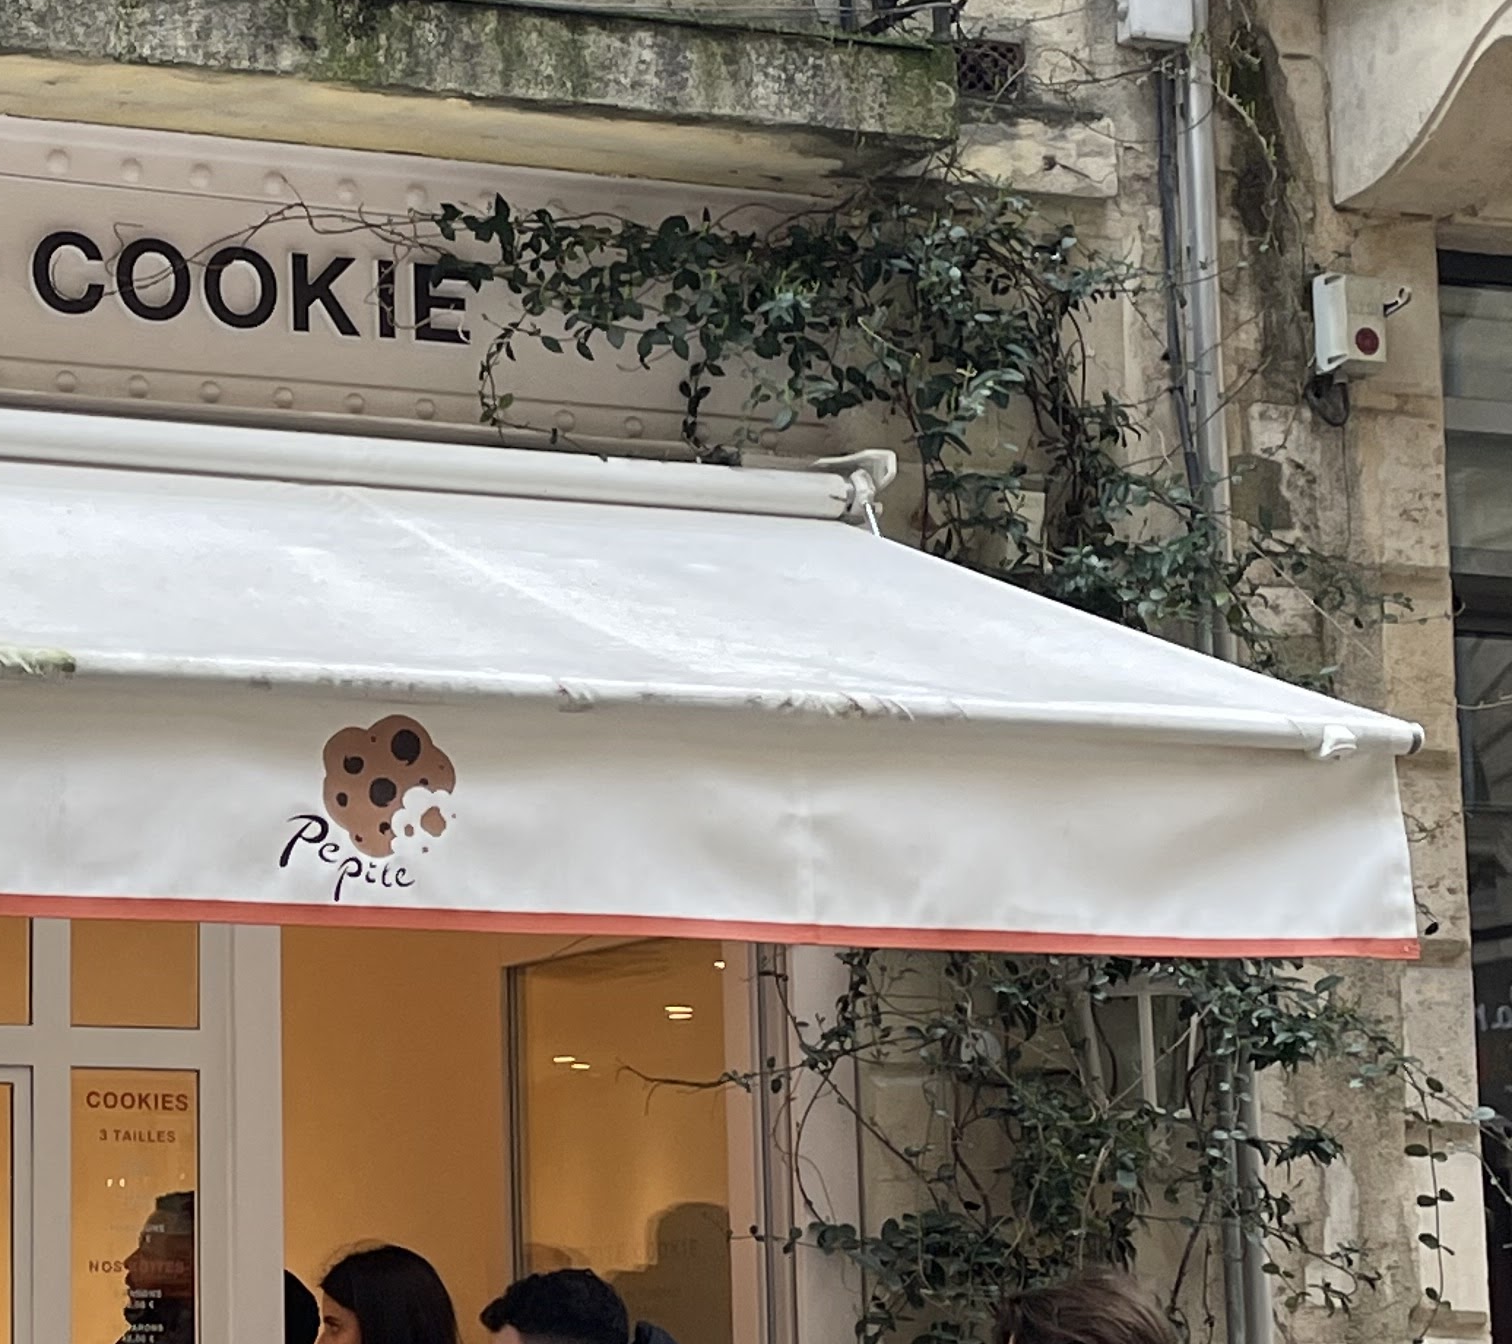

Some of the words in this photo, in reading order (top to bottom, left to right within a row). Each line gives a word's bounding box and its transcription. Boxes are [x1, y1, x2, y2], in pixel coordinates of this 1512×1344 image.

[31, 230, 471, 345] COOKIE
[85, 1090, 189, 1112] COOKIES
[99, 1129, 108, 1142] 3
[113, 1129, 177, 1143] TAILLES
[88, 1260, 123, 1274] NOS
